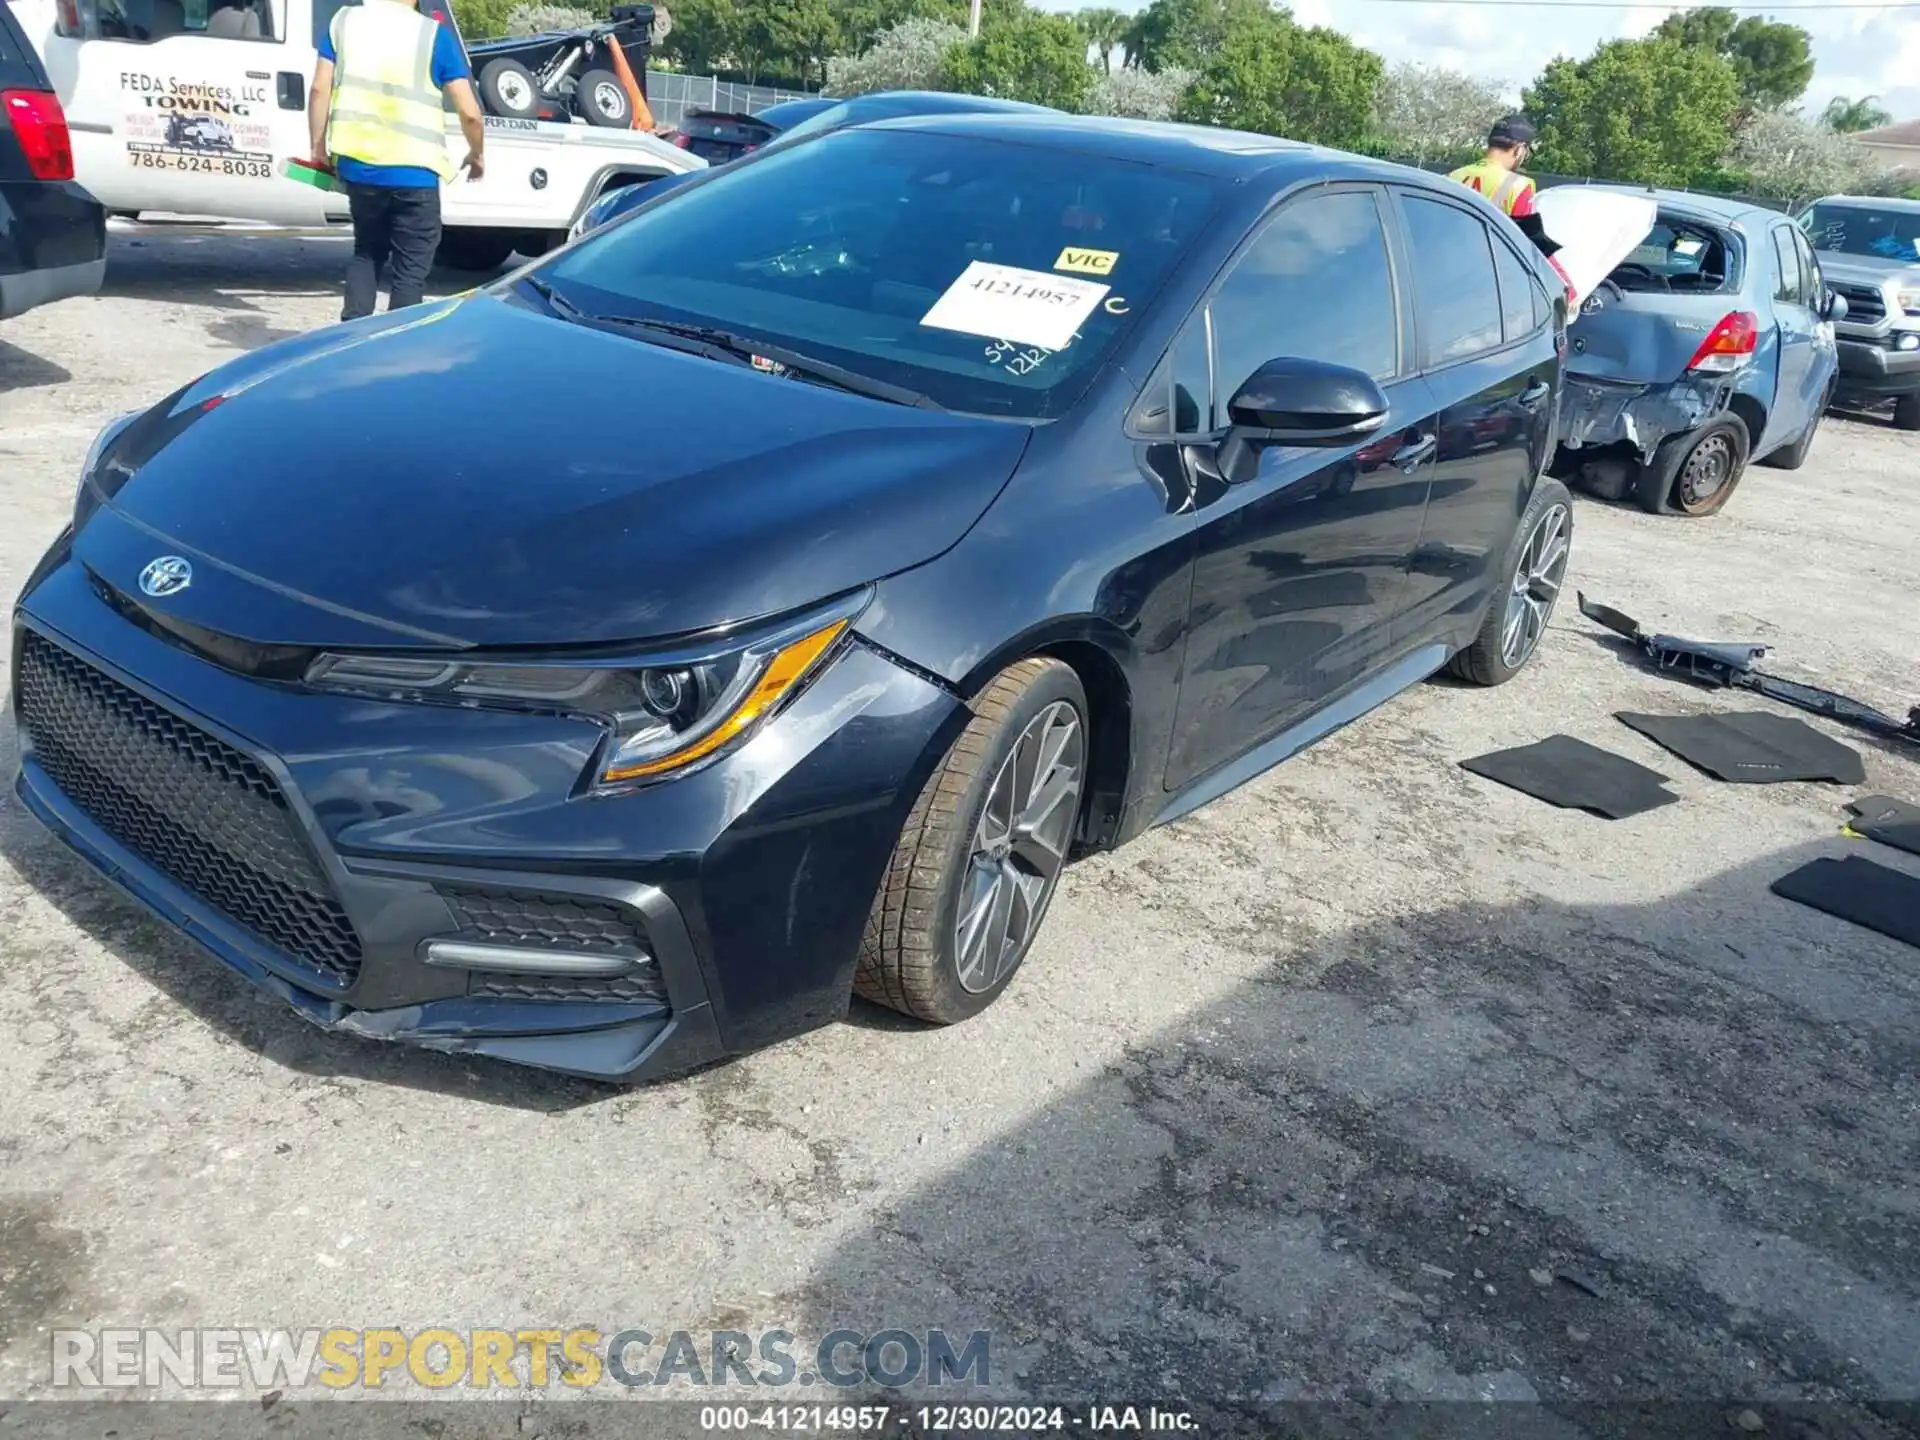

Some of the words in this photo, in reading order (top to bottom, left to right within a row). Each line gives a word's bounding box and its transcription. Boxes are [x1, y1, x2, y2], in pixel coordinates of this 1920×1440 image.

[120, 72, 164, 93] FEDA
[241, 86, 266, 103] LLC
[142, 95, 250, 117] TOWING
[129, 152, 272, 178] 786-624-8038
[1065, 252, 1111, 269] VIC
[969, 278, 1081, 306] 41214957
